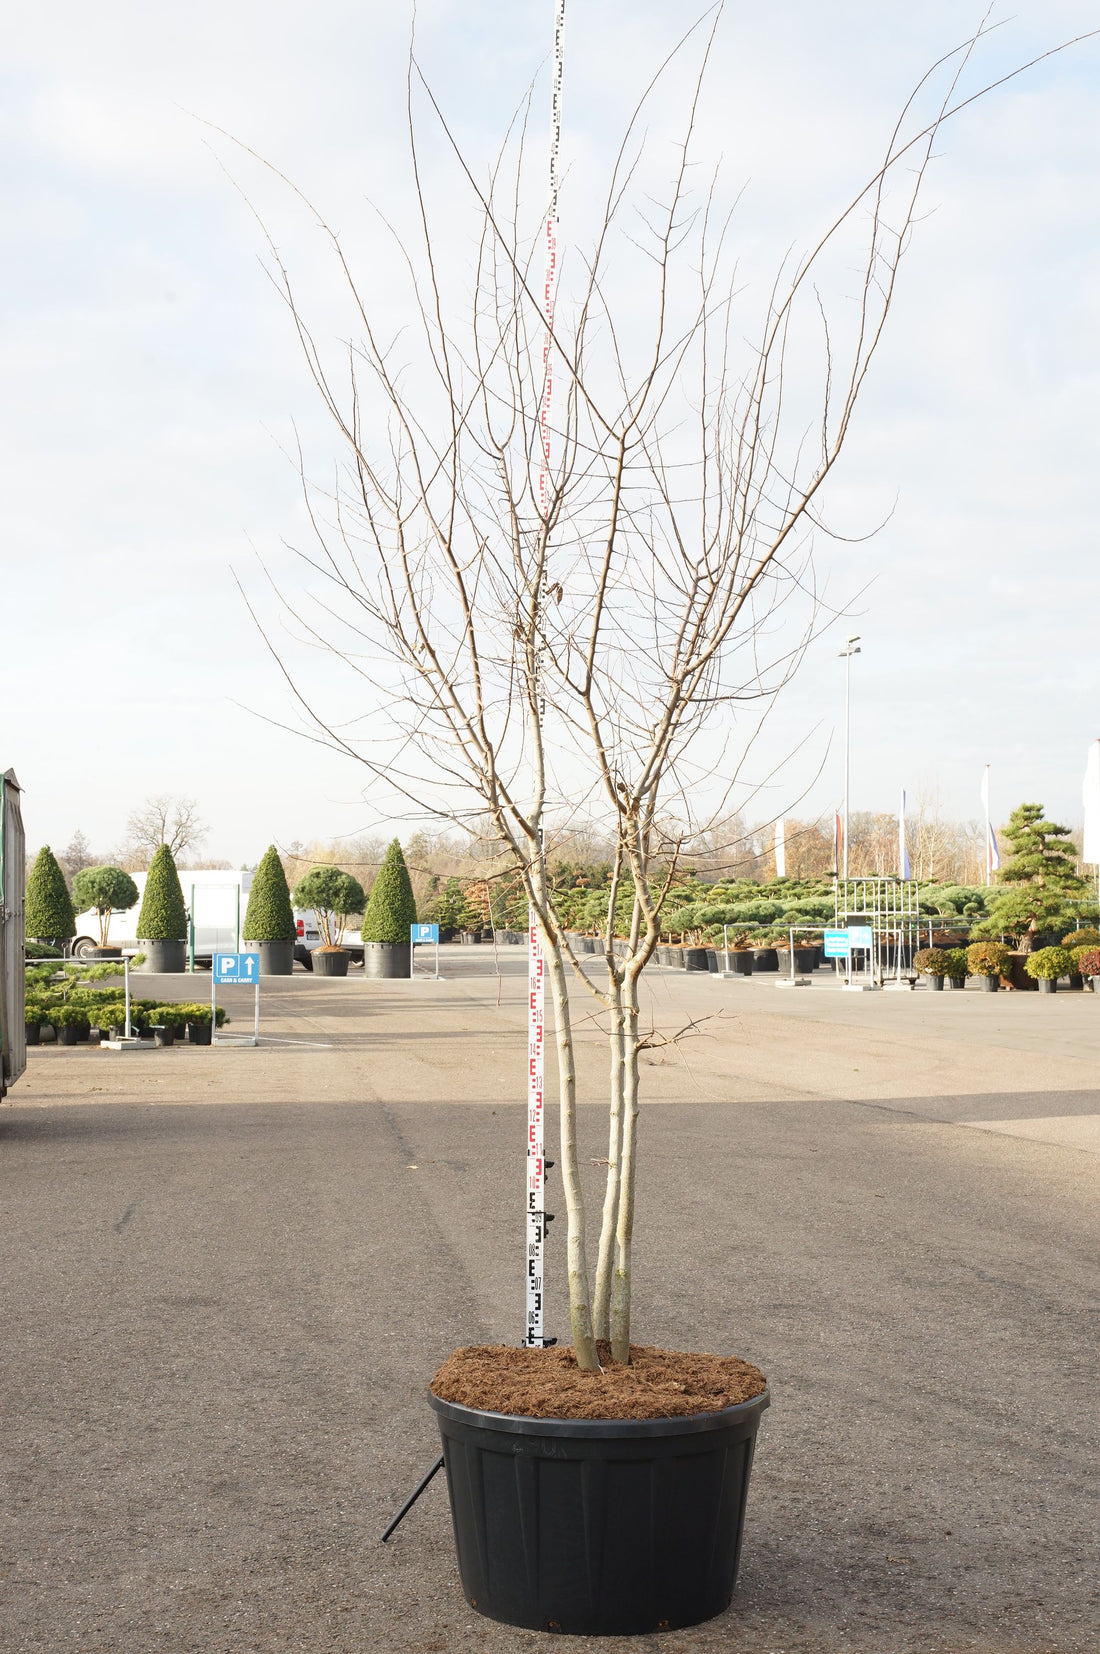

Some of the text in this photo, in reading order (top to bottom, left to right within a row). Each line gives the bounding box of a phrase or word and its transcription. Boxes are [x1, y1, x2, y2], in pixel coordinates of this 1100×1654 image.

[420, 926, 429, 936] P
[221, 957, 235, 974] P
[530, 976, 536, 990] 16
[536, 1010, 543, 1023] 15
[529, 1043, 536, 1056] 14
[536, 1076, 542, 1089] 13
[529, 1109, 536, 1122] 12
[535, 1276, 541, 1290] 07
